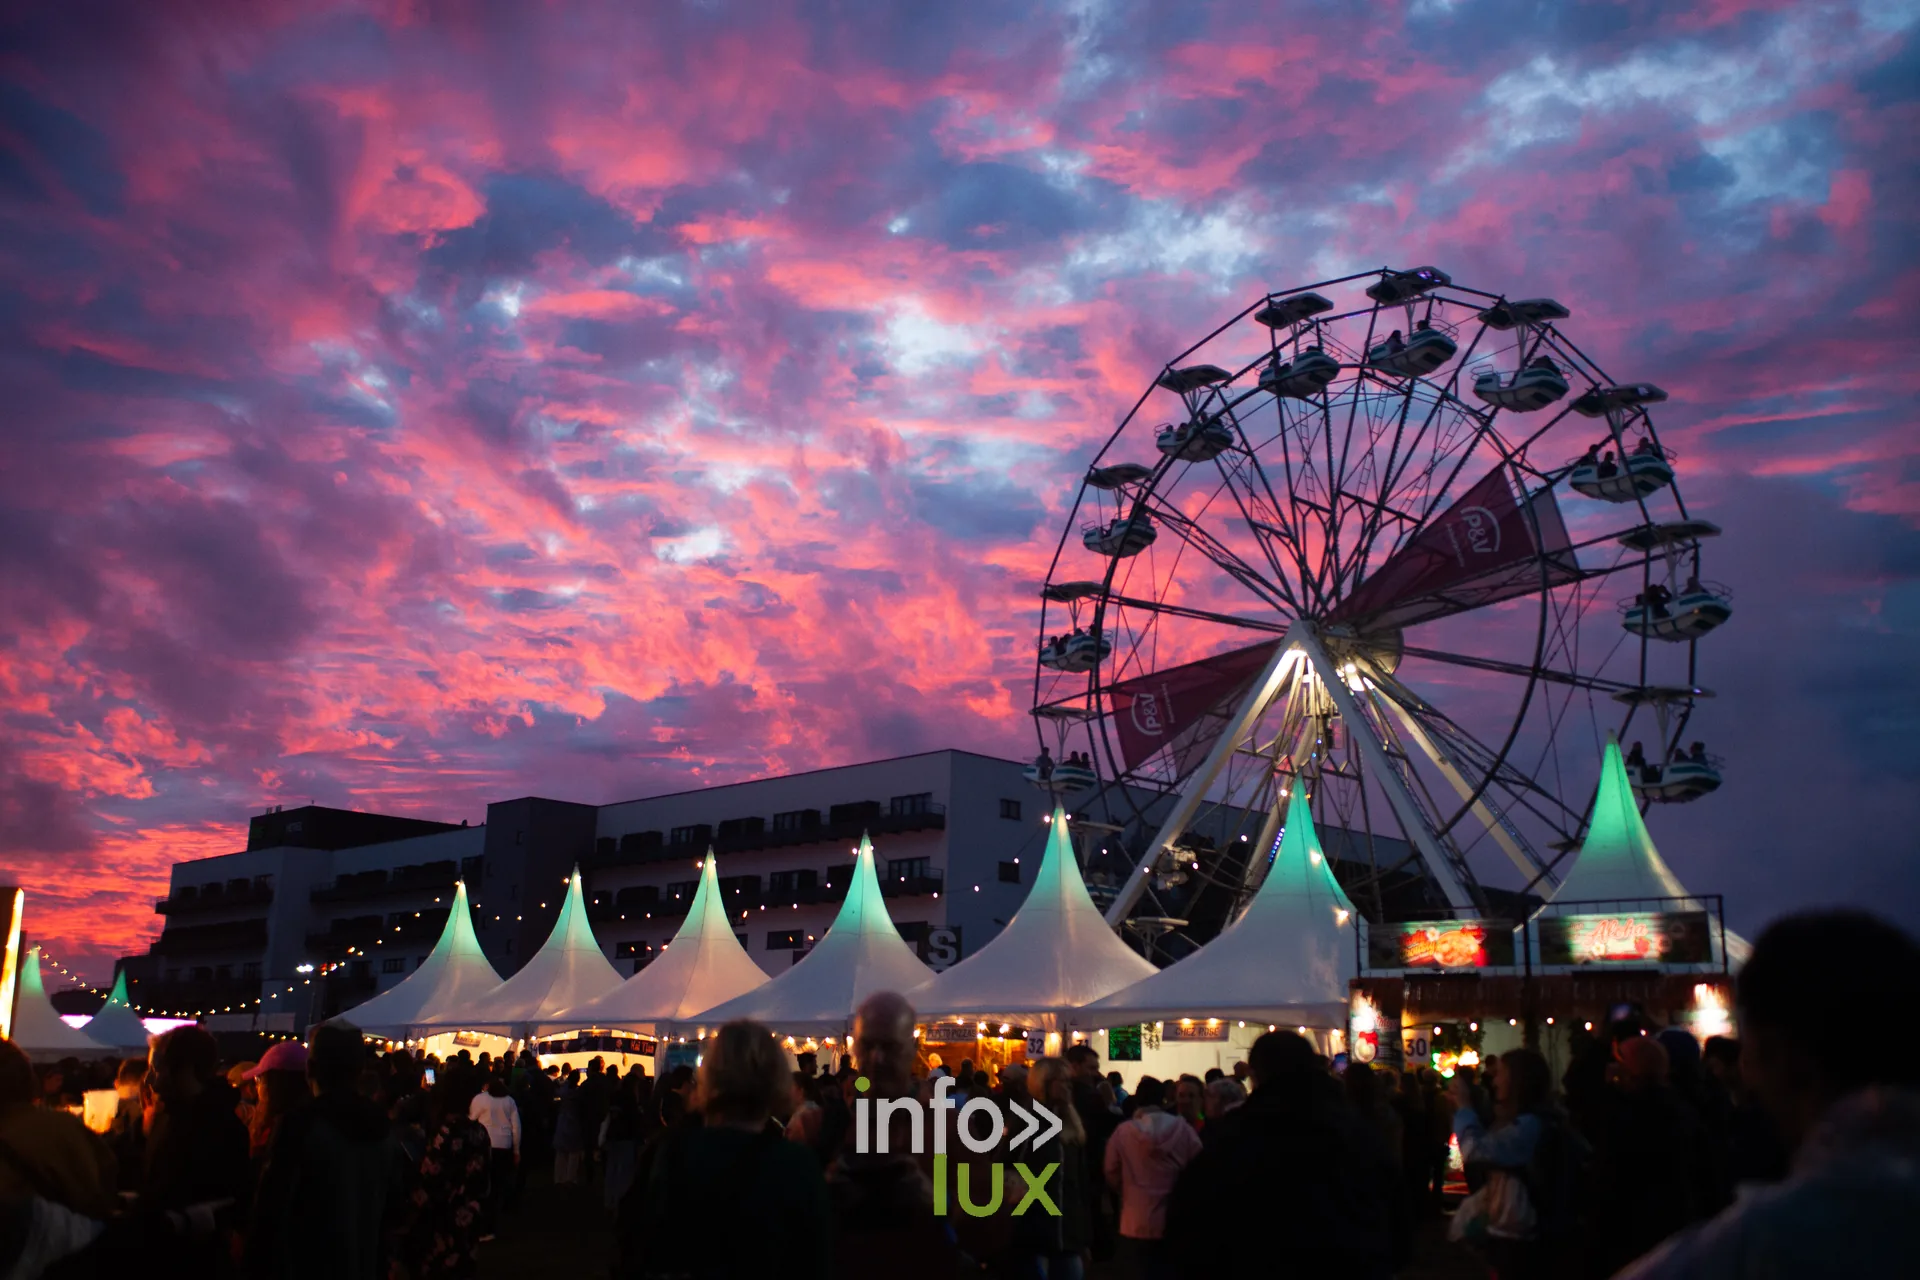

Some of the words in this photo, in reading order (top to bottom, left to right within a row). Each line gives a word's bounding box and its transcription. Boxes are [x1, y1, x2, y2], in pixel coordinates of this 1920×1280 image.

[1462, 514, 1492, 552] P&V
[1139, 693, 1162, 729] P&V
[1585, 918, 1649, 944] Aloha
[952, 1028, 976, 1038] PIZZAS
[1175, 1026, 1196, 1037] CHEZ
[1198, 1026, 1219, 1037] ROSE
[1028, 1038, 1044, 1054] 32
[1405, 1038, 1426, 1056] 30
